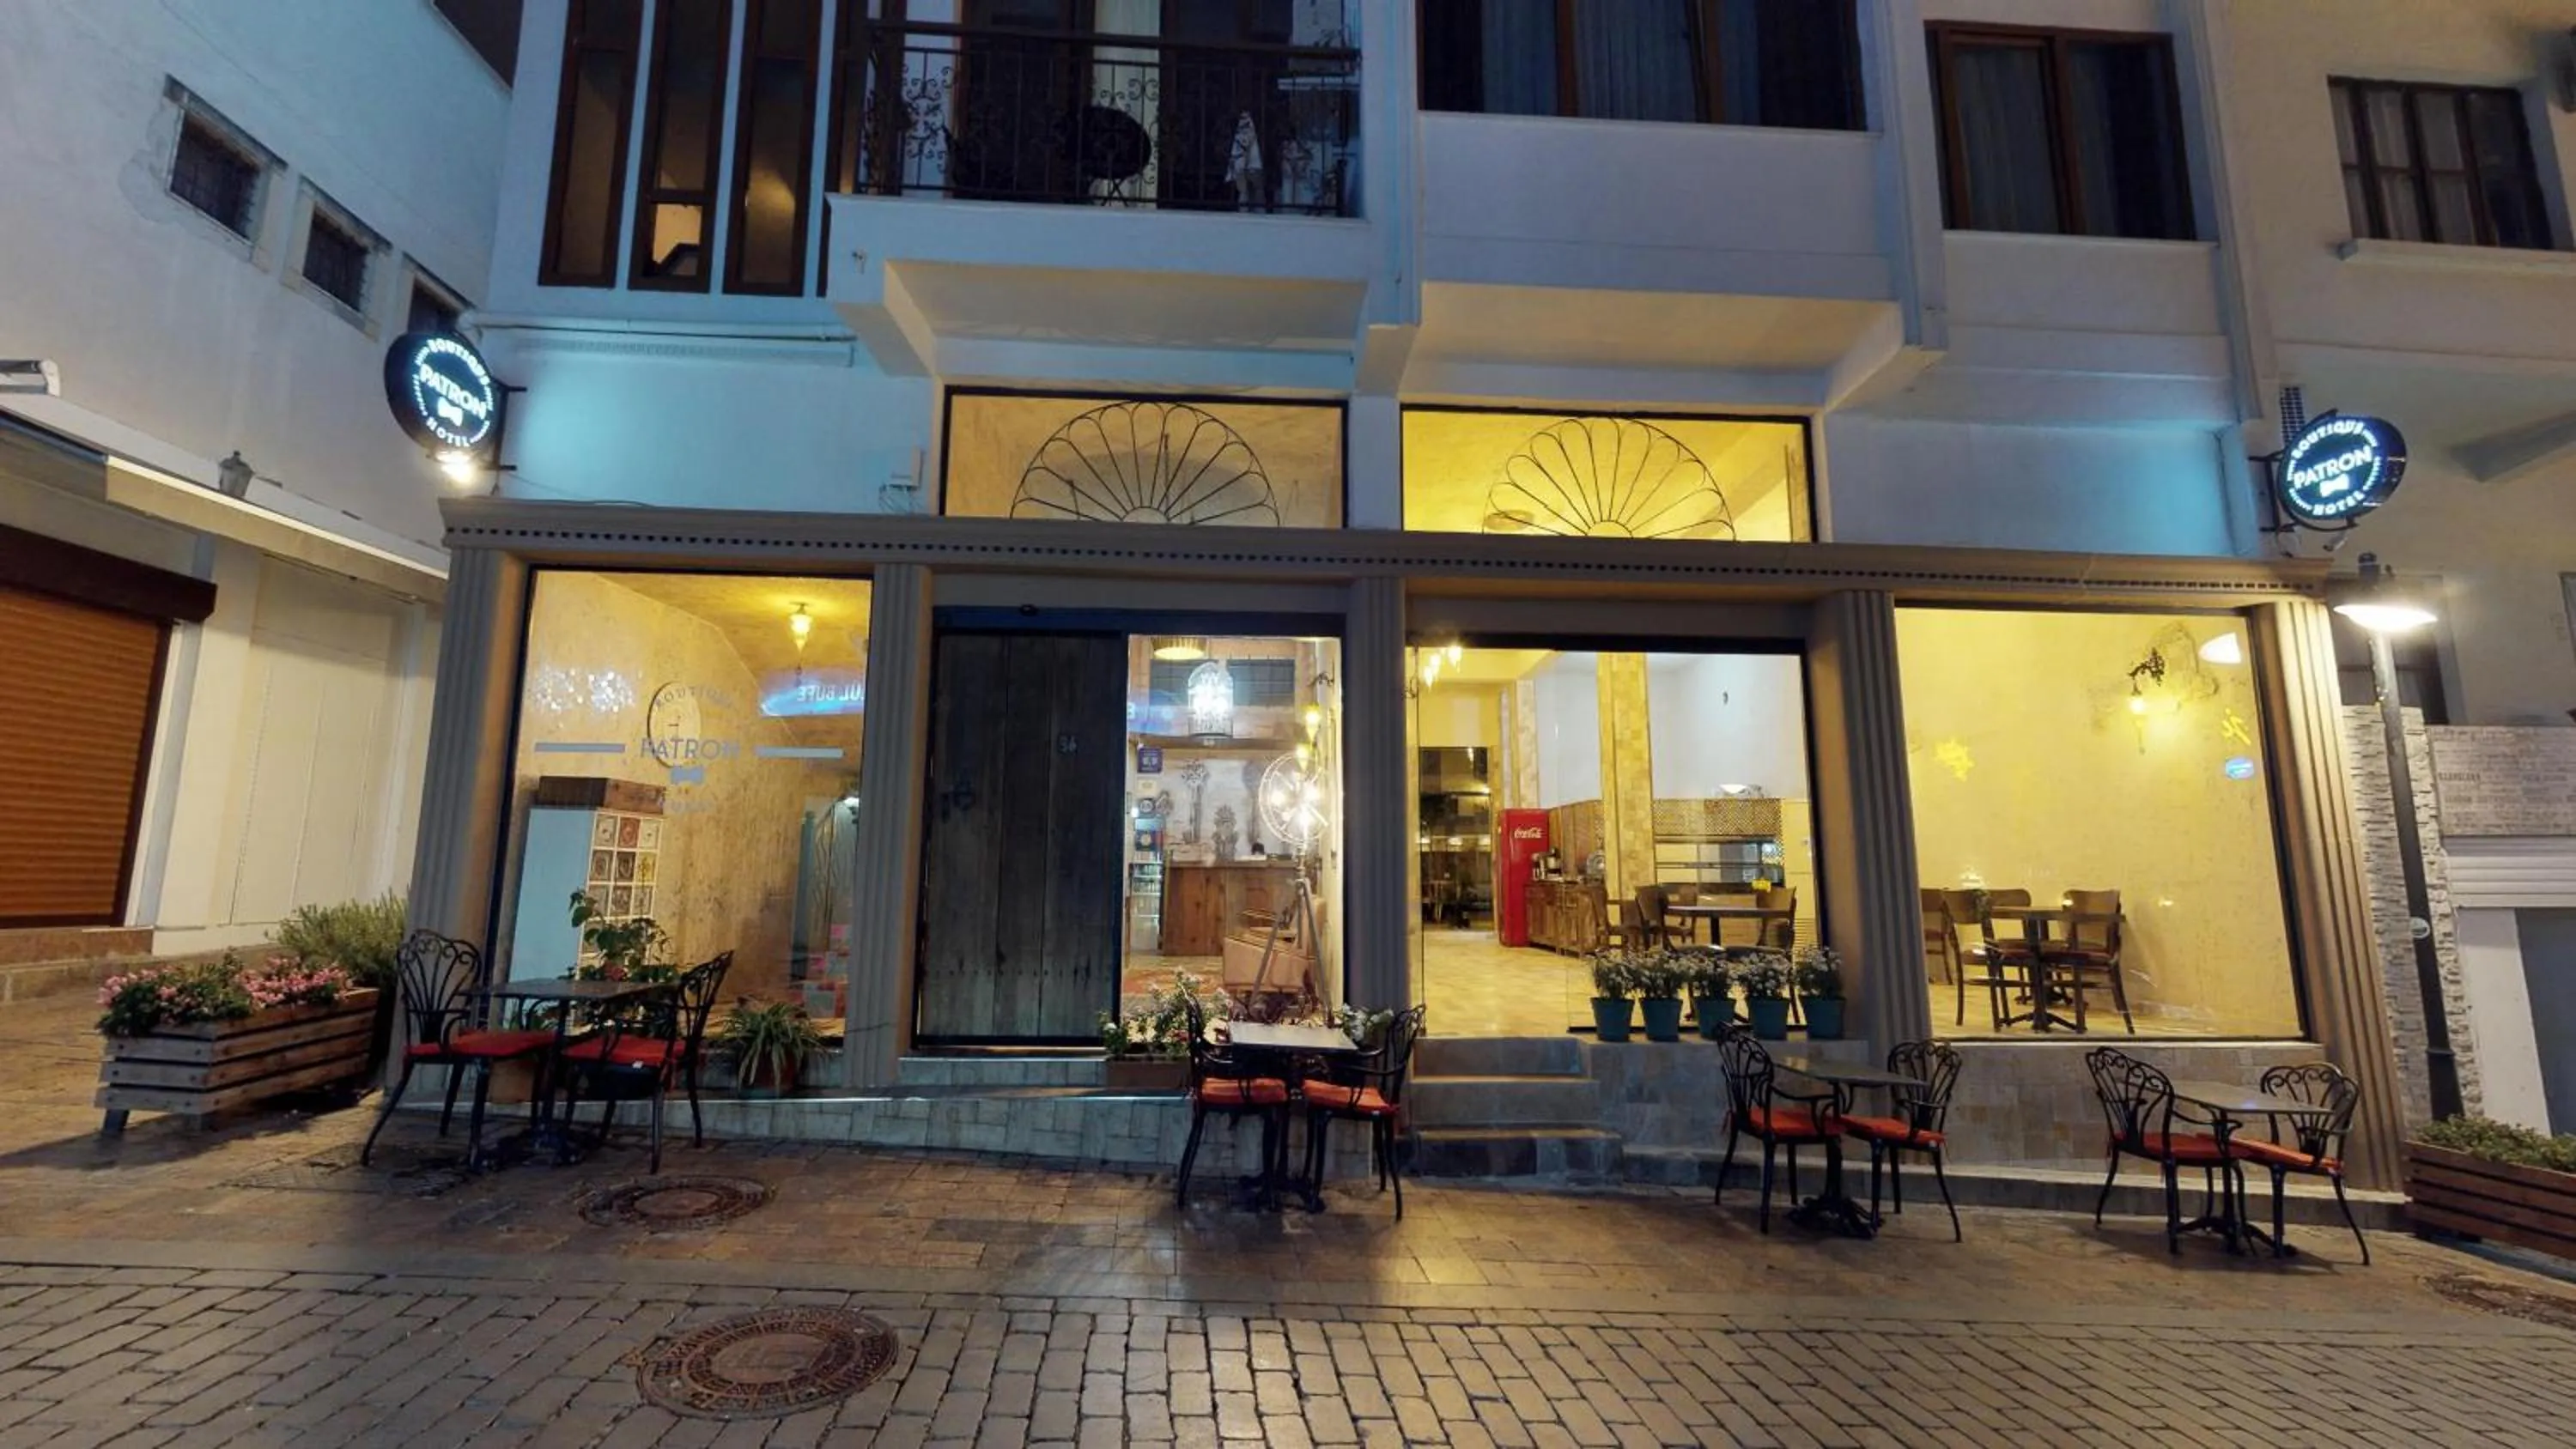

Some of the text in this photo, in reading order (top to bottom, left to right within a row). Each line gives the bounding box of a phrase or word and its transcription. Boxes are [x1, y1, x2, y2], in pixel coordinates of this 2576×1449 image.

[426, 337, 491, 385] BOUTIQUE
[419, 362, 487, 420] PATRON
[426, 416, 471, 447] HOTEL
[2290, 420, 2366, 459] BOUTIQUE
[2293, 444, 2373, 489] PATRON
[2312, 489, 2366, 516] HOTEL
[639, 737, 741, 761] PATRON
